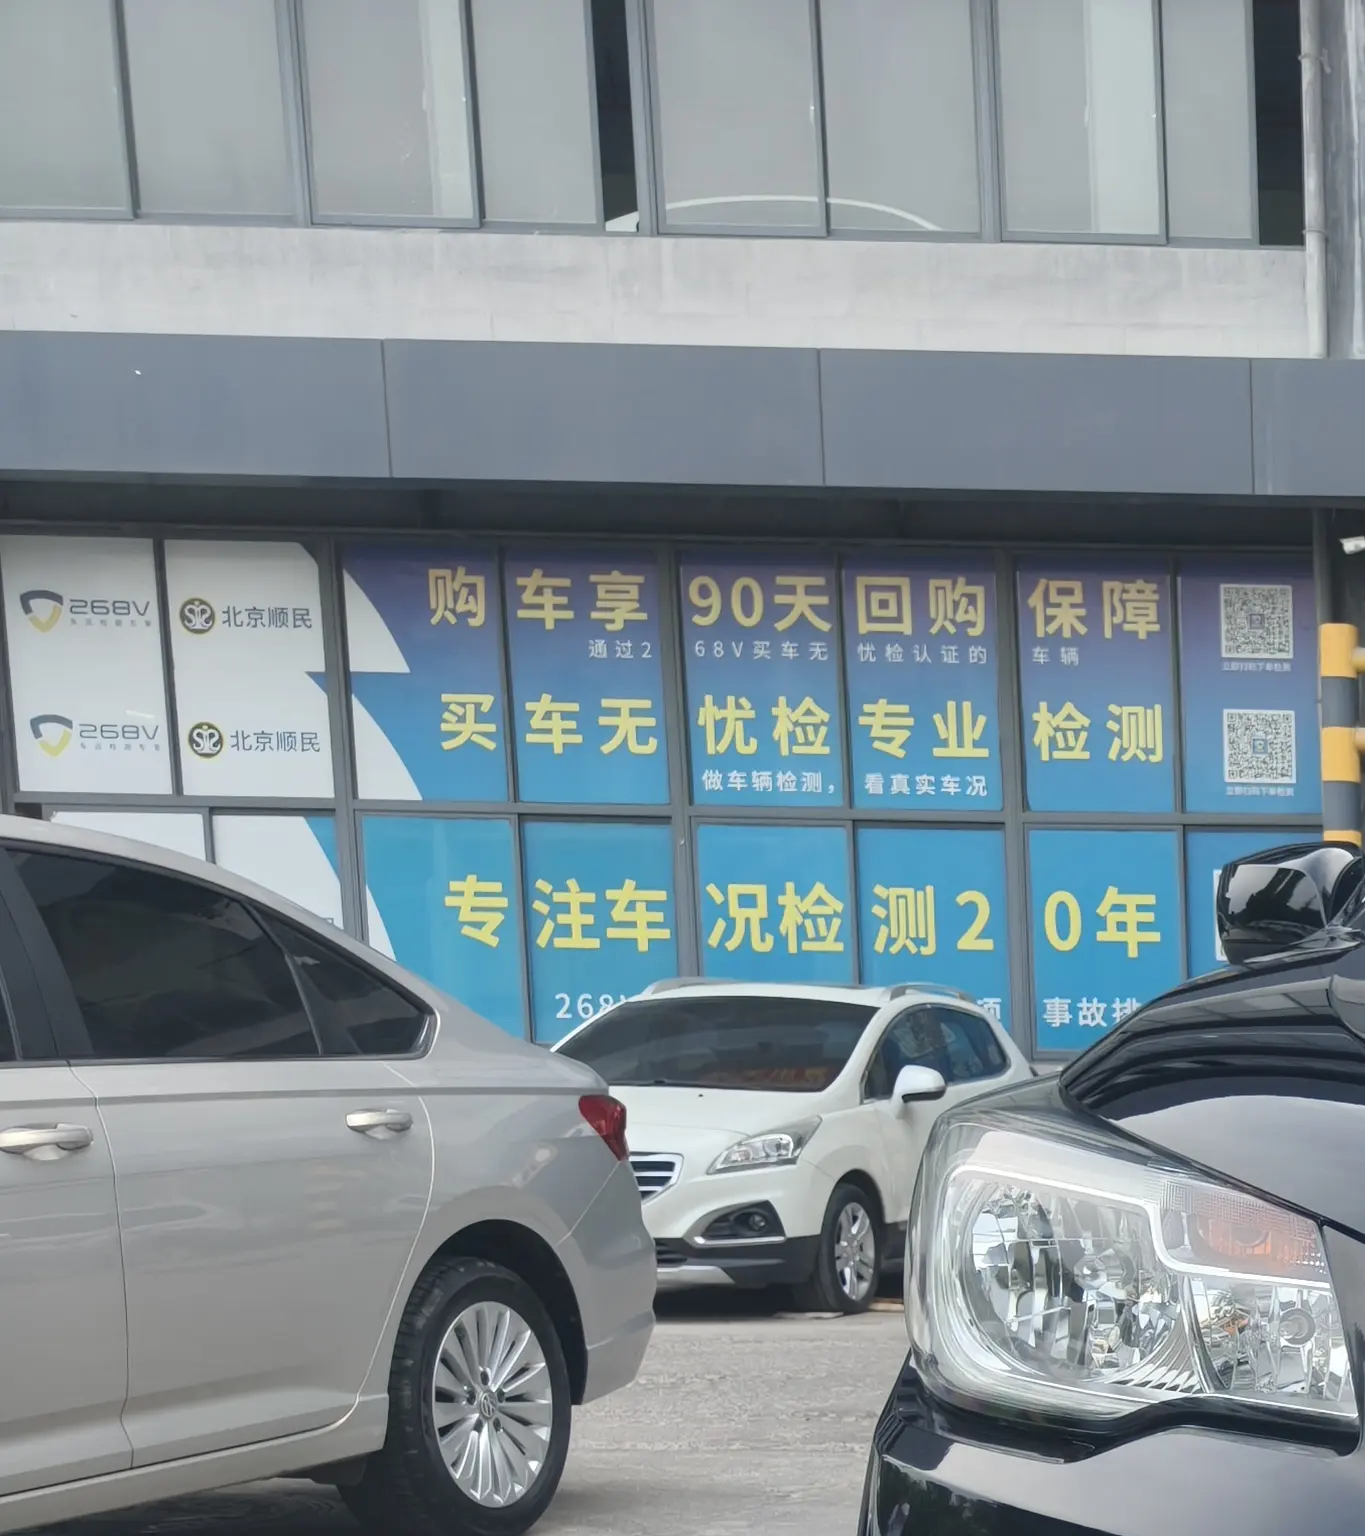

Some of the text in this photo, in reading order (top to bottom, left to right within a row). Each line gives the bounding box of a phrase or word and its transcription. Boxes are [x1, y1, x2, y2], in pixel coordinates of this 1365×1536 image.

[69, 599, 151, 617] 268V
[222, 605, 313, 629] 北京顺民
[79, 724, 160, 740] 268V
[230, 730, 321, 753] 北京顺民
[555, 993, 627, 1020] 268
